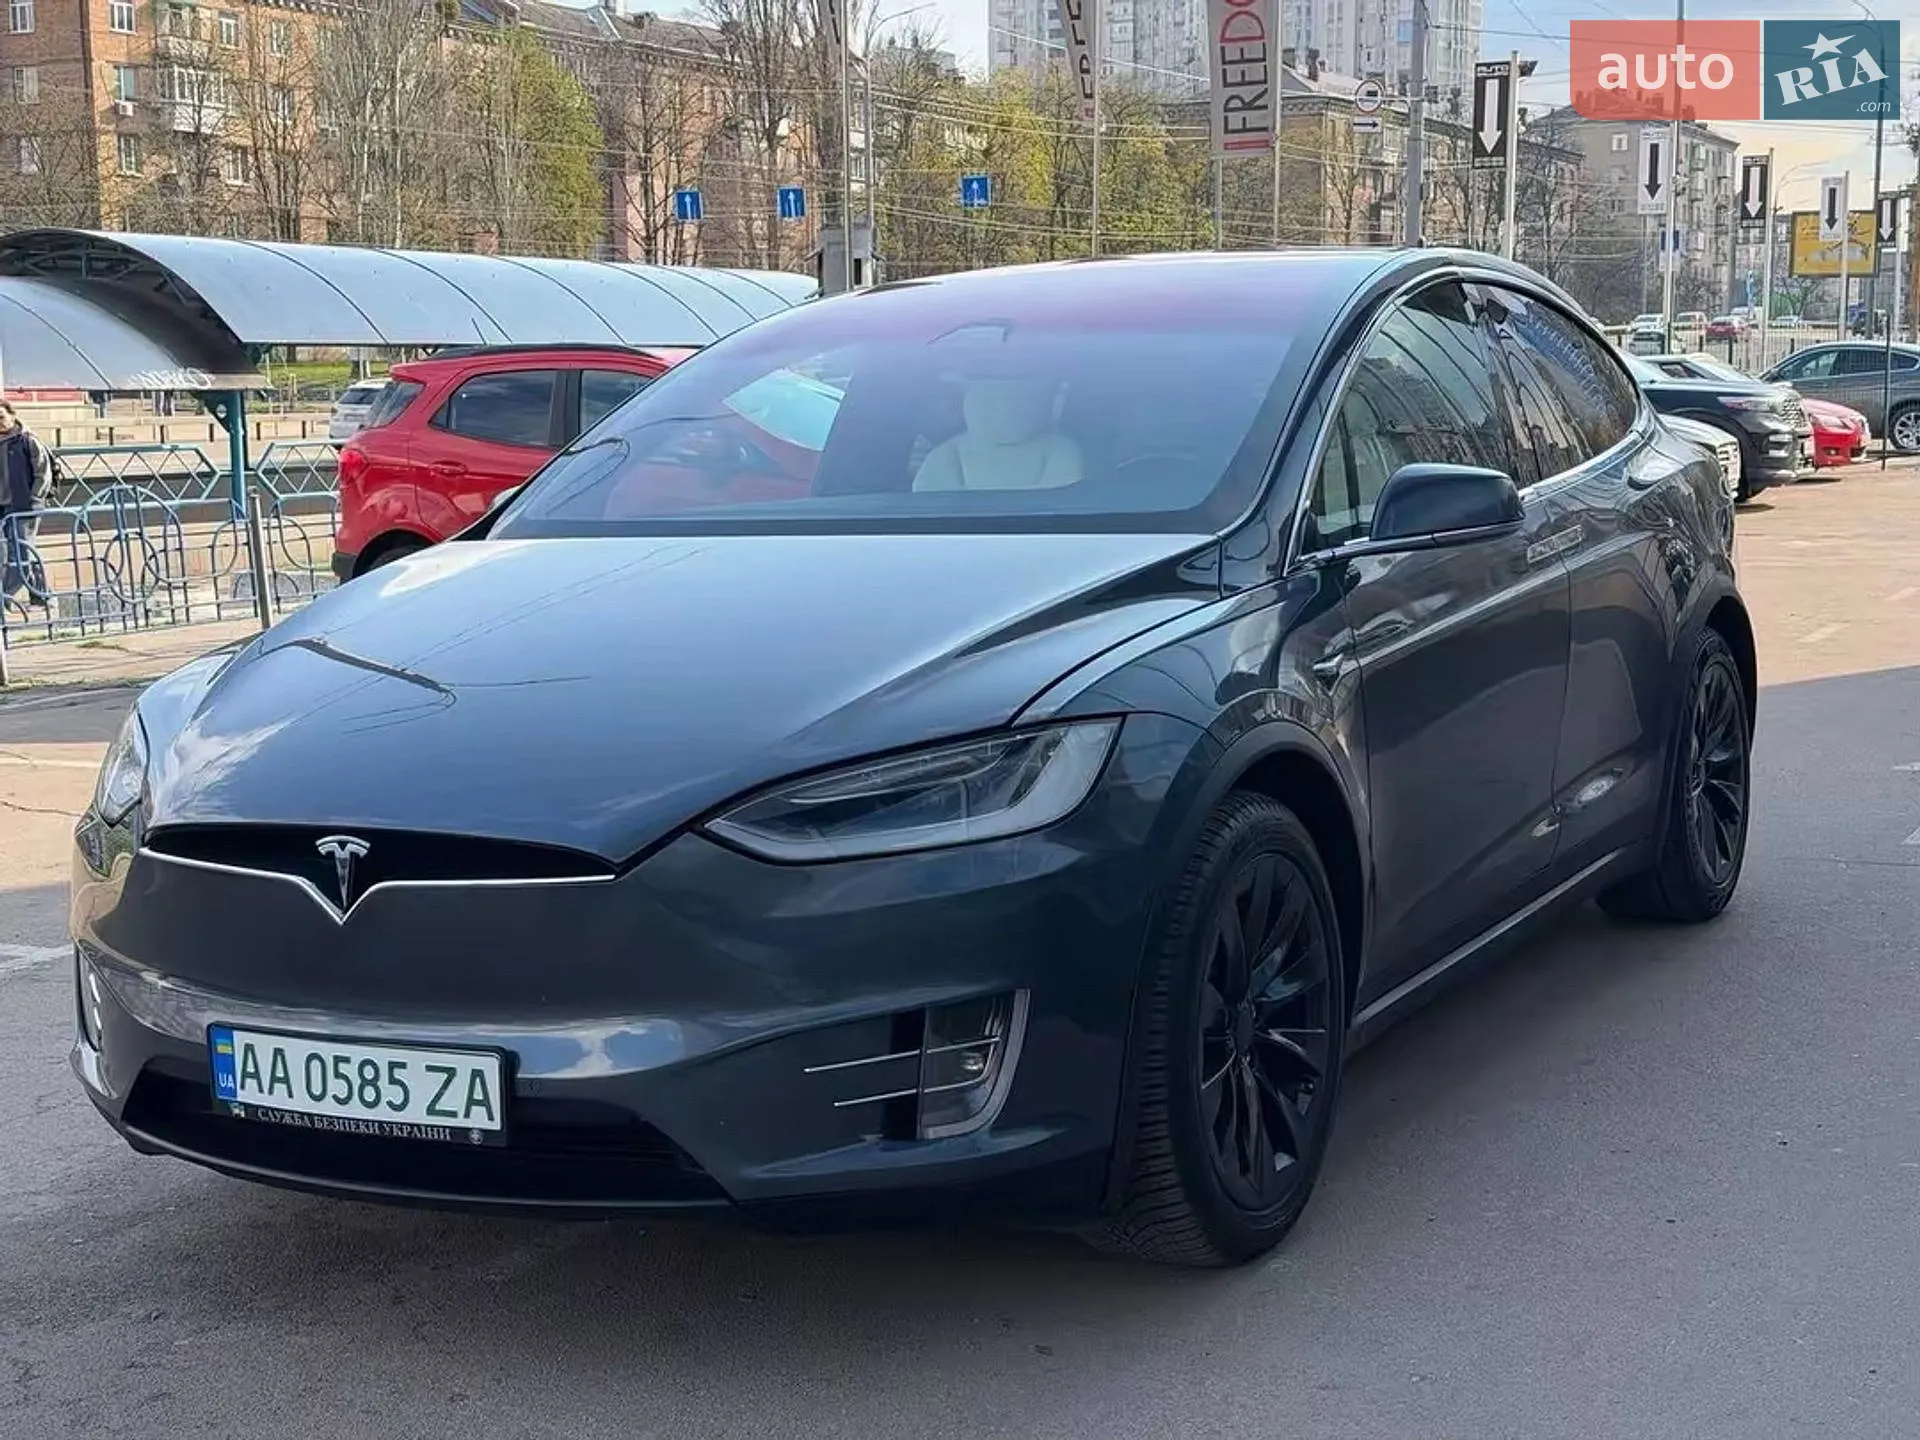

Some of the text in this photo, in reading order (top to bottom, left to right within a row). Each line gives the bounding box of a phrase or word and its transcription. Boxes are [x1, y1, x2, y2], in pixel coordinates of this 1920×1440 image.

[1219, 0, 1269, 134] FREED
[218, 1072, 236, 1090] UA
[239, 1042, 495, 1122] AA 0585 ZA
[257, 1108, 312, 1128] СЛУЖБА
[313, 1116, 380, 1135] БЕЗПЕКИ
